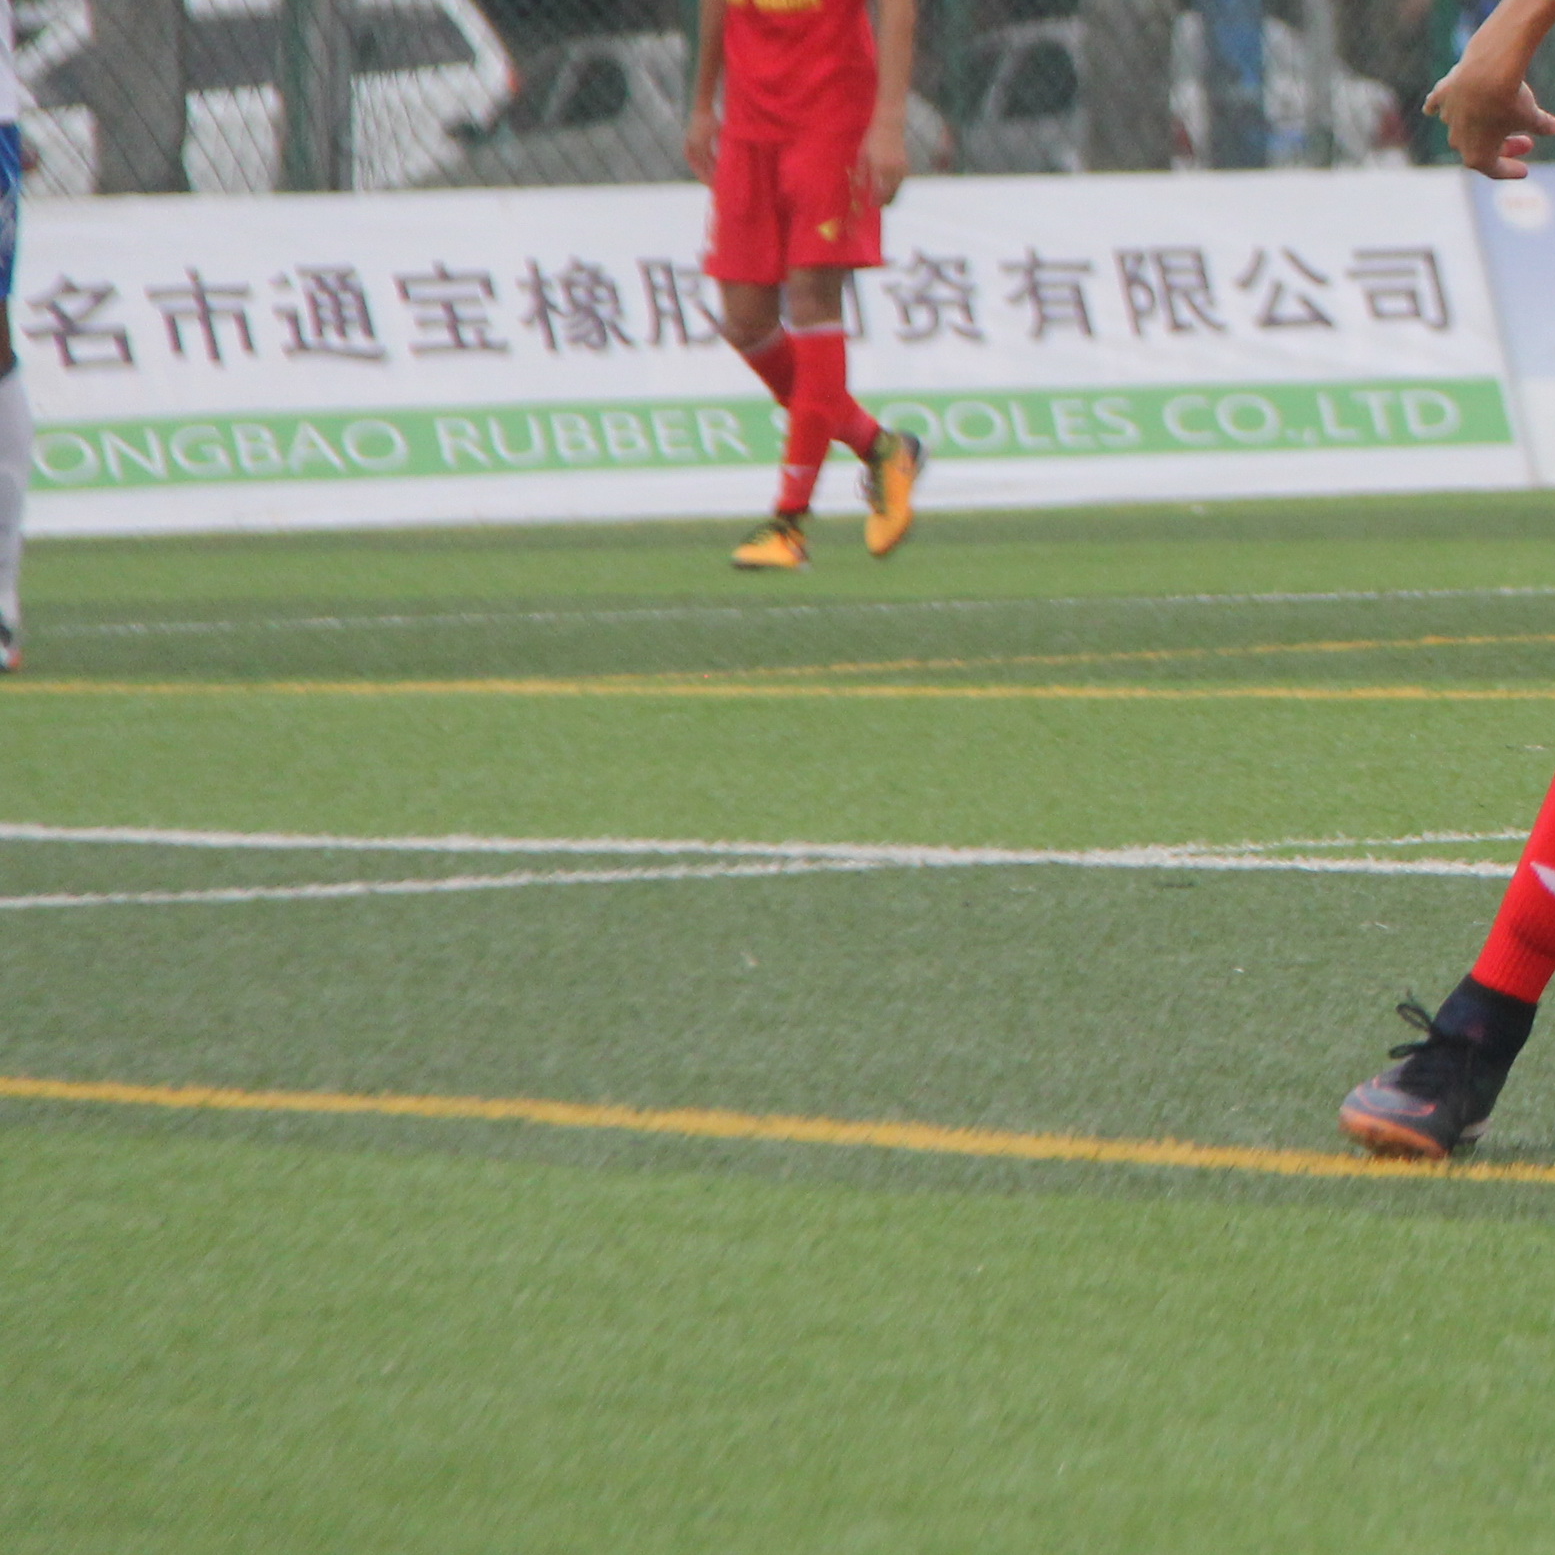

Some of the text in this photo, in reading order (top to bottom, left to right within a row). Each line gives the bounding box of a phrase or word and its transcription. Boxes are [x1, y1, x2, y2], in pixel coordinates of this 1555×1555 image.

[22, 244, 1456, 370] 名市通宝橡胶资有限公司
[28, 417, 410, 485] ONGBAO
[432, 406, 753, 467] RUBBER
